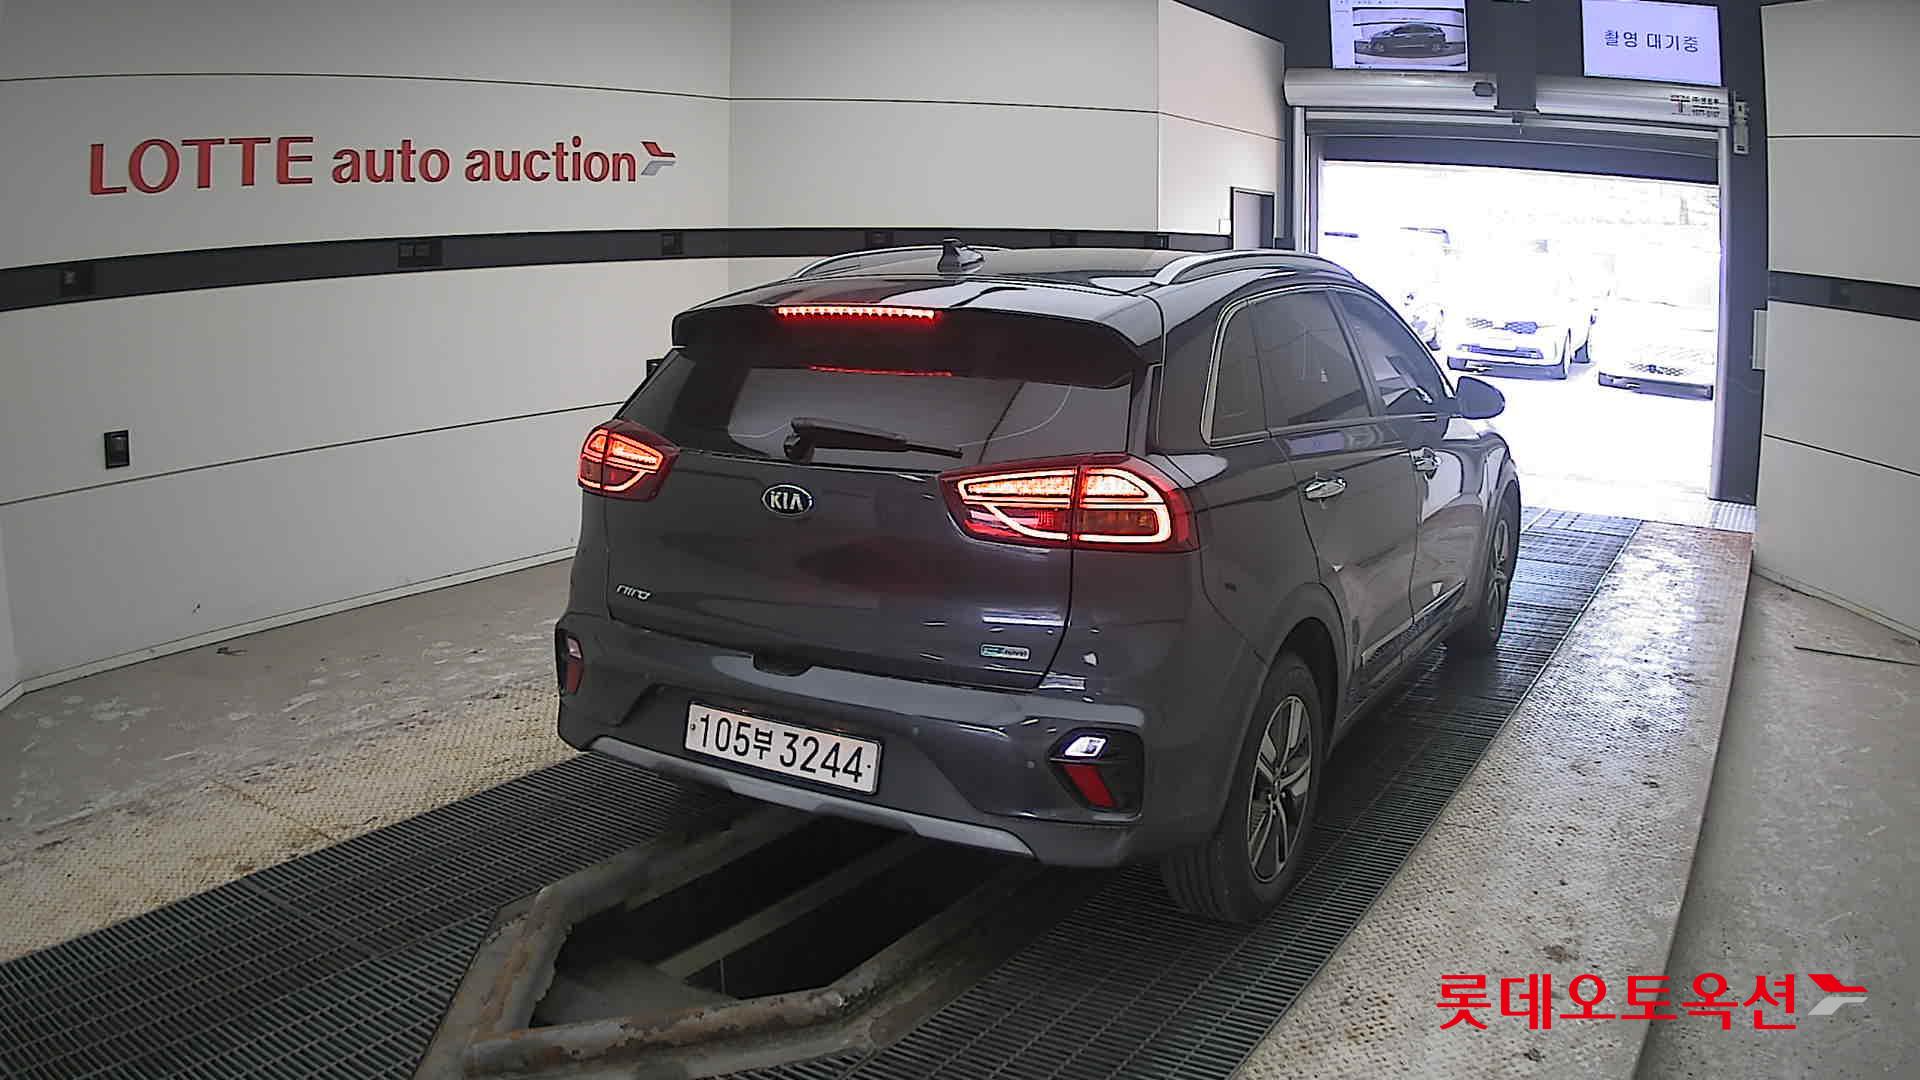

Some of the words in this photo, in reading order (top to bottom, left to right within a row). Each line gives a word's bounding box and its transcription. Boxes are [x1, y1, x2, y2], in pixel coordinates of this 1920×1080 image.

[1646, 33, 1699, 53] 대기중
[89, 136, 314, 196] LOTTE
[331, 139, 450, 184] auto
[464, 135, 637, 183] auction
[770, 490, 804, 511] KIA
[700, 713, 773, 760] 105부
[779, 731, 863, 783] 3244
